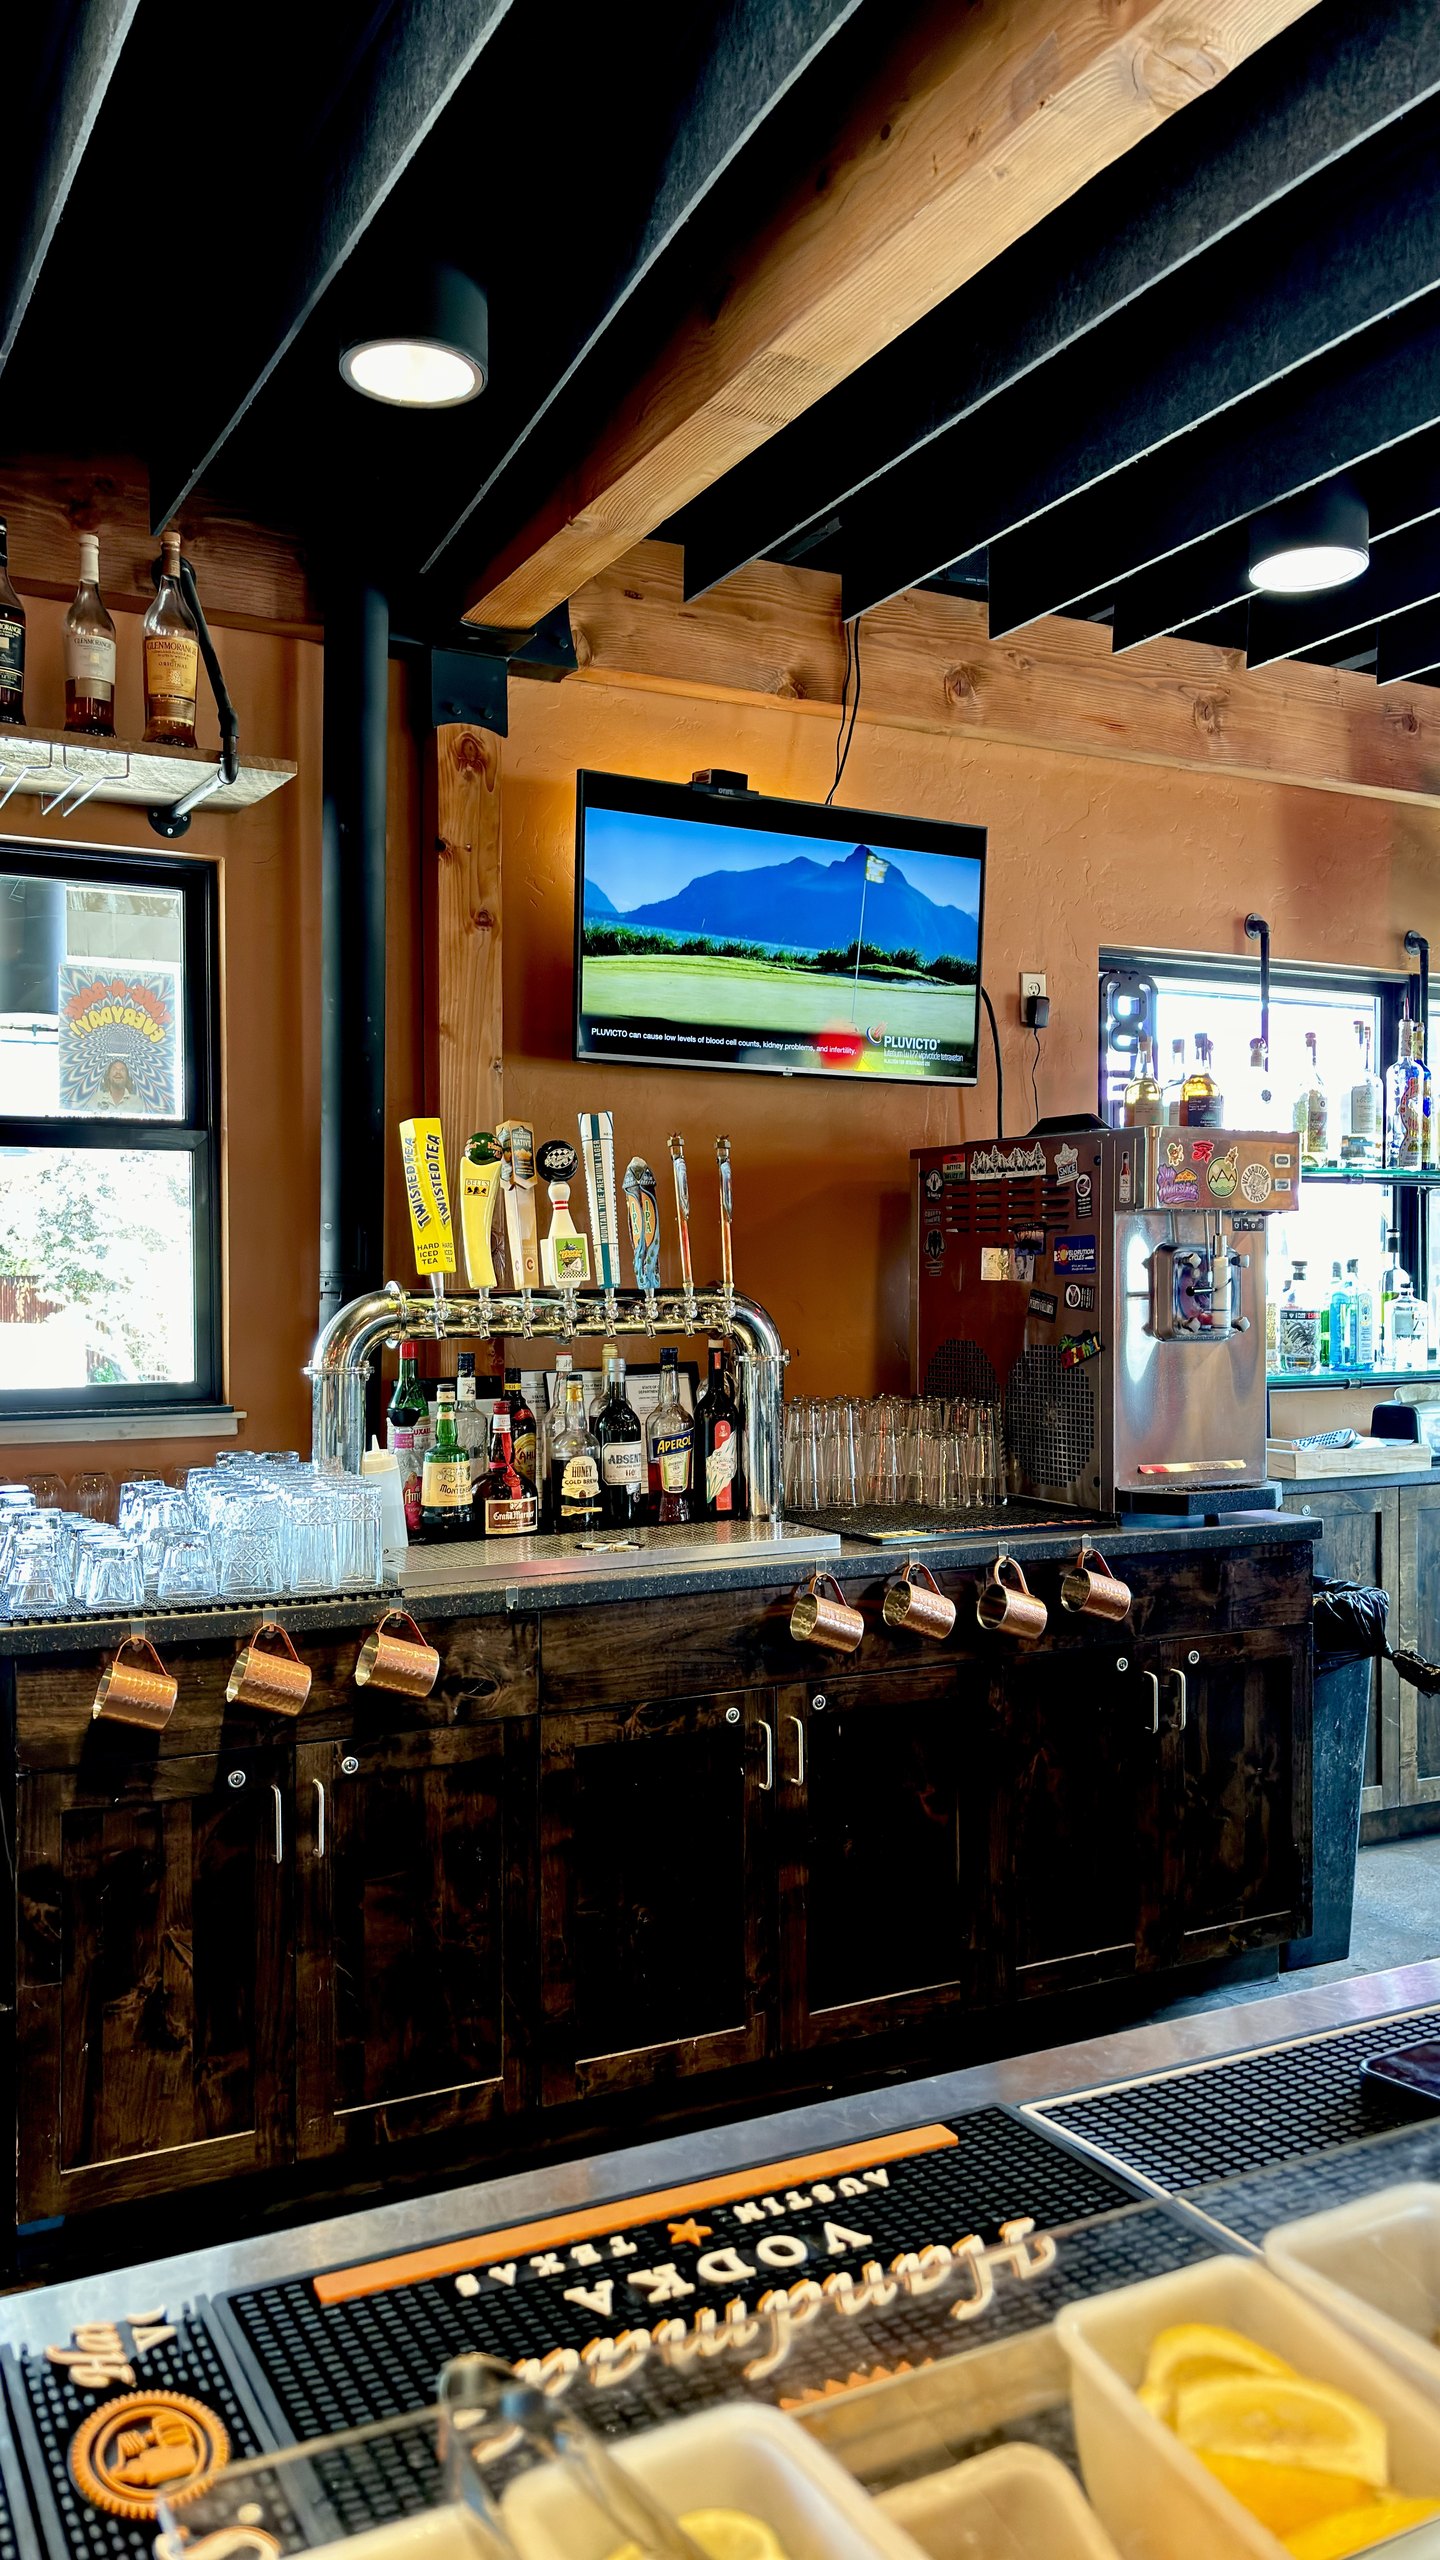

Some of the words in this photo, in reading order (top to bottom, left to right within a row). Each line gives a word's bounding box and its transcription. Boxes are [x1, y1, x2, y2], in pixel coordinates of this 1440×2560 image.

[74, 637, 112, 649] GLENMORANGIE
[147, 641, 197, 656] GLENMORANGIE
[158, 661, 188, 669] ORIGINAL
[591, 1027, 628, 1038] PLUVICTO
[628, 1031, 641, 1039] can
[643, 1033, 663, 1041] cause
[664, 1033, 676, 1041] low
[677, 1035, 696, 1043] levels
[706, 1037, 725, 1045] blood
[738, 1040, 762, 1048] counts,
[762, 1041, 783, 1050] kidney
[784, 1043, 815, 1052] problems,
[829, 1046, 857, 1056] infertility.
[884, 1035, 938, 1051] PLUVICTO
[403, 1137, 416, 1163] TEA
[426, 1134, 440, 1161] TEA
[513, 1138, 532, 1148] NATIVE
[593, 1139, 601, 1161] LAGER
[595, 1162, 604, 1192] PREMIUM
[1242, 1165, 1270, 1185] VELORUTION
[404, 1165, 431, 1229] TWISTED
[427, 1163, 451, 1226] TWISTED
[1249, 1192, 1266, 1203] CYCLES
[598, 1211, 609, 1244] MOUNTAIN
[631, 1203, 639, 1234] IPA
[417, 1242, 440, 1251] HARD
[420, 1250, 438, 1258] ICED
[526, 1259, 533, 1270] C
[656, 1435, 692, 1454] APEROL
[608, 1453, 641, 1465] ABSENT
[571, 1465, 592, 1478] HONEY
[732, 2168, 890, 2224] AUSTIN
[455, 2236, 637, 2297] TEXAS
[565, 2221, 872, 2317] VODKA
[485, 2217, 1057, 2428] Handmad
